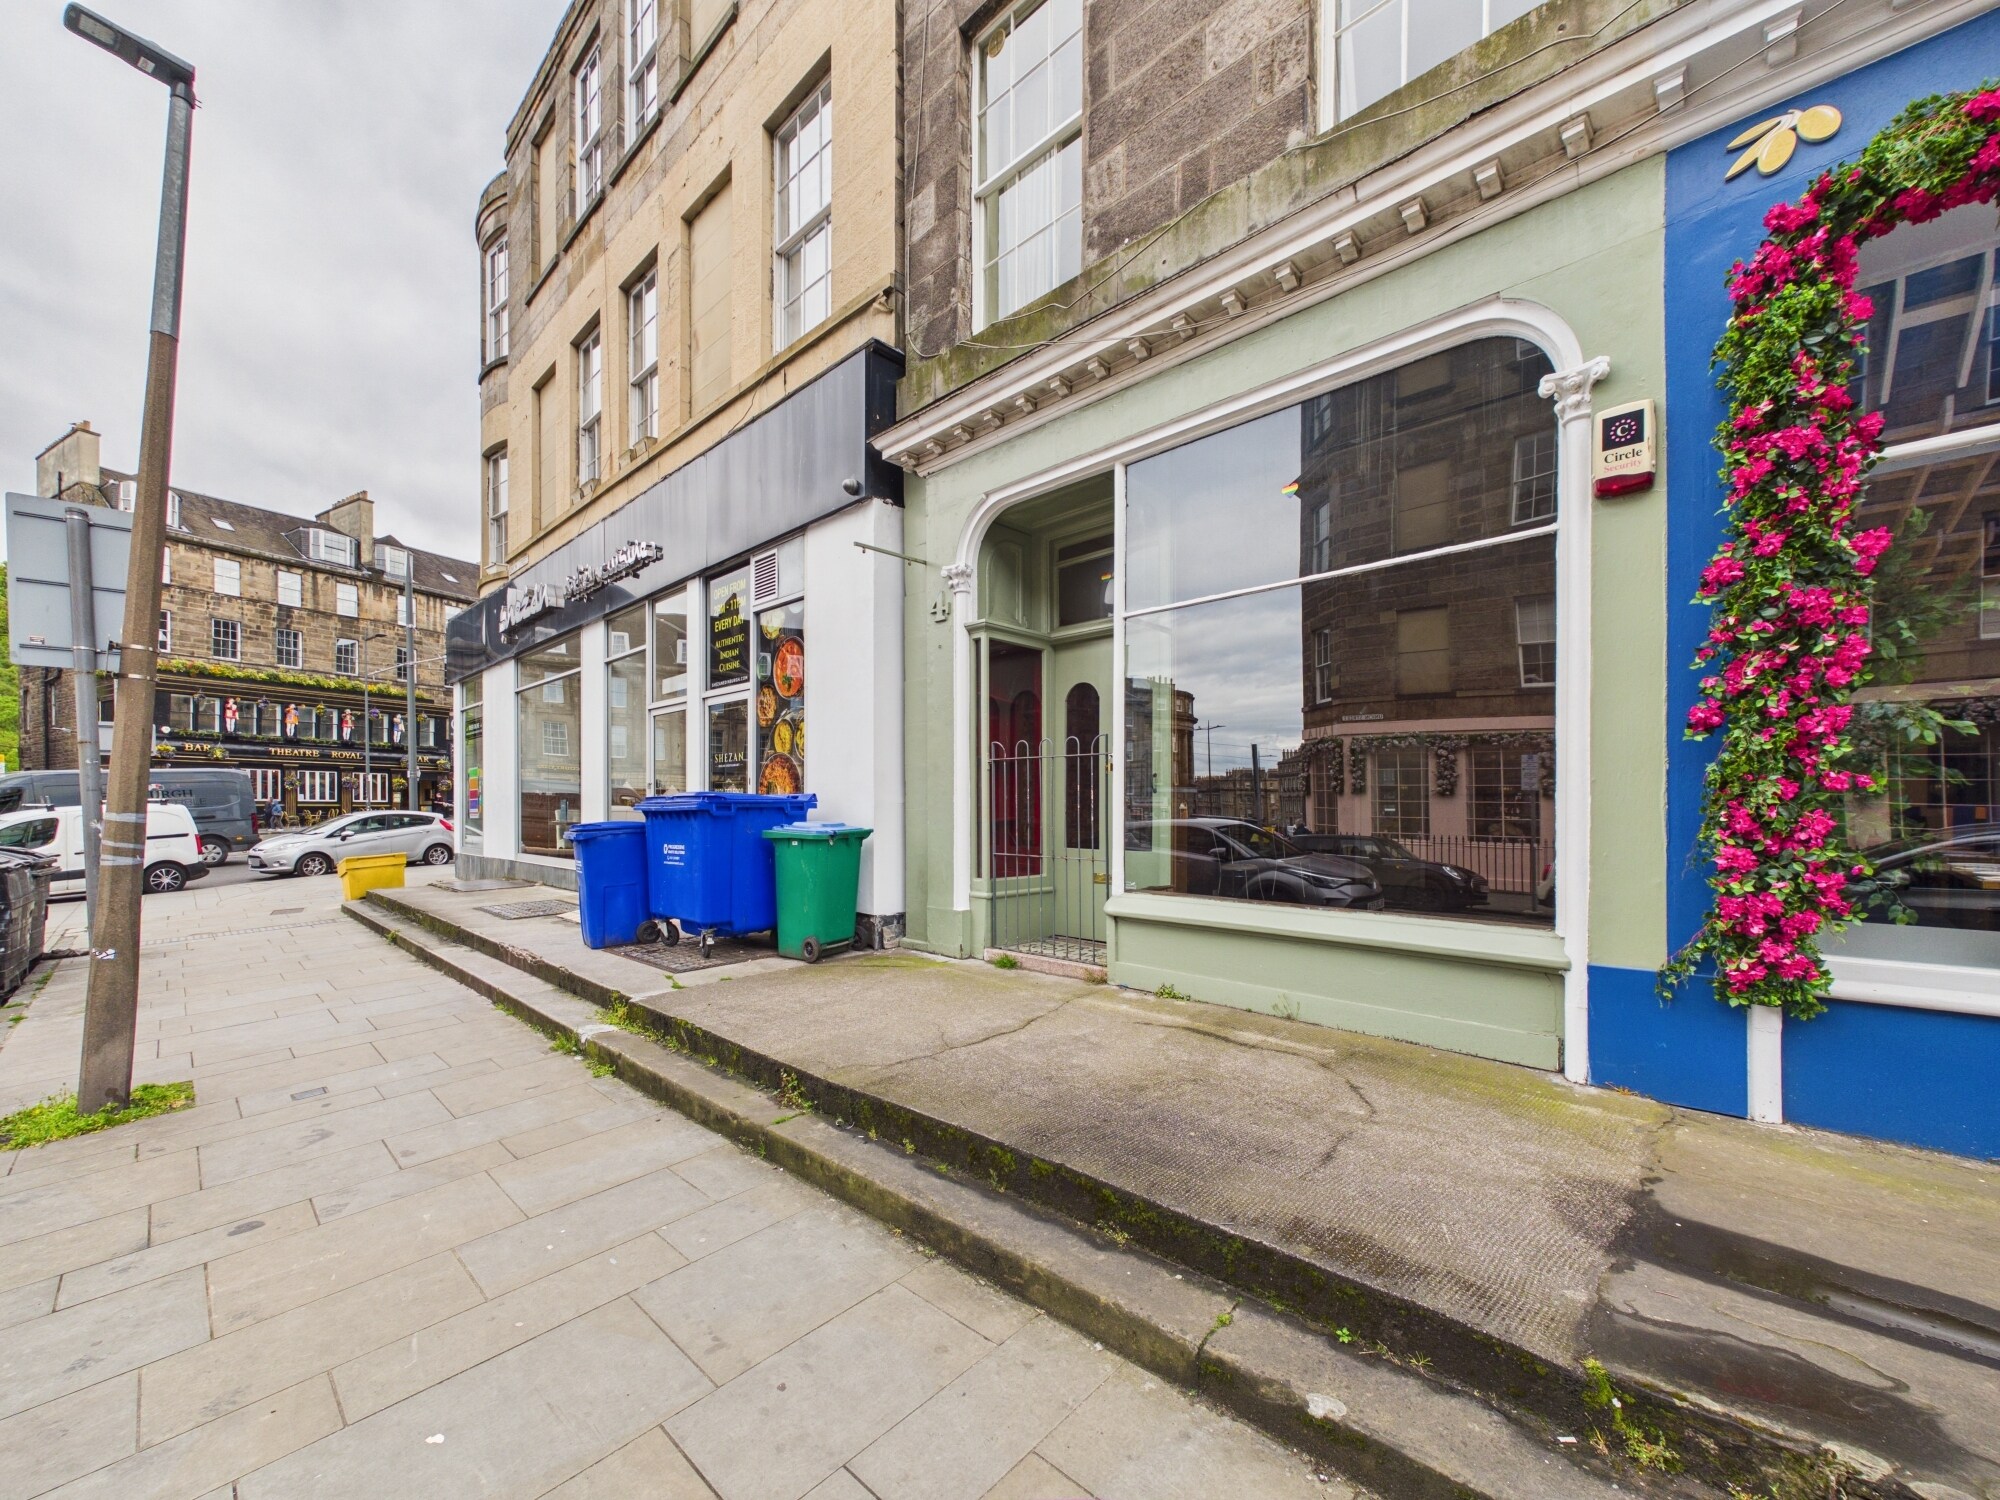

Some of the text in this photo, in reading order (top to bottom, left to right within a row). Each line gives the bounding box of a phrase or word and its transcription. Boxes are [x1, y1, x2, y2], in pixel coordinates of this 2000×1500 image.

[1604, 448, 1643, 464] Circle
[1603, 459, 1643, 473] Security
[713, 578, 746, 600] OPEN FROM
[714, 613, 745, 633] EVERY DAY
[715, 633, 745, 649] AUTHENTIC
[720, 648, 739, 660] INDIAN
[719, 660, 740, 672] CUISINE
[184, 742, 211, 752] BAR
[269, 747, 364, 760] THEATRE ROYAL
[714, 751, 744, 763] SHEZAN
